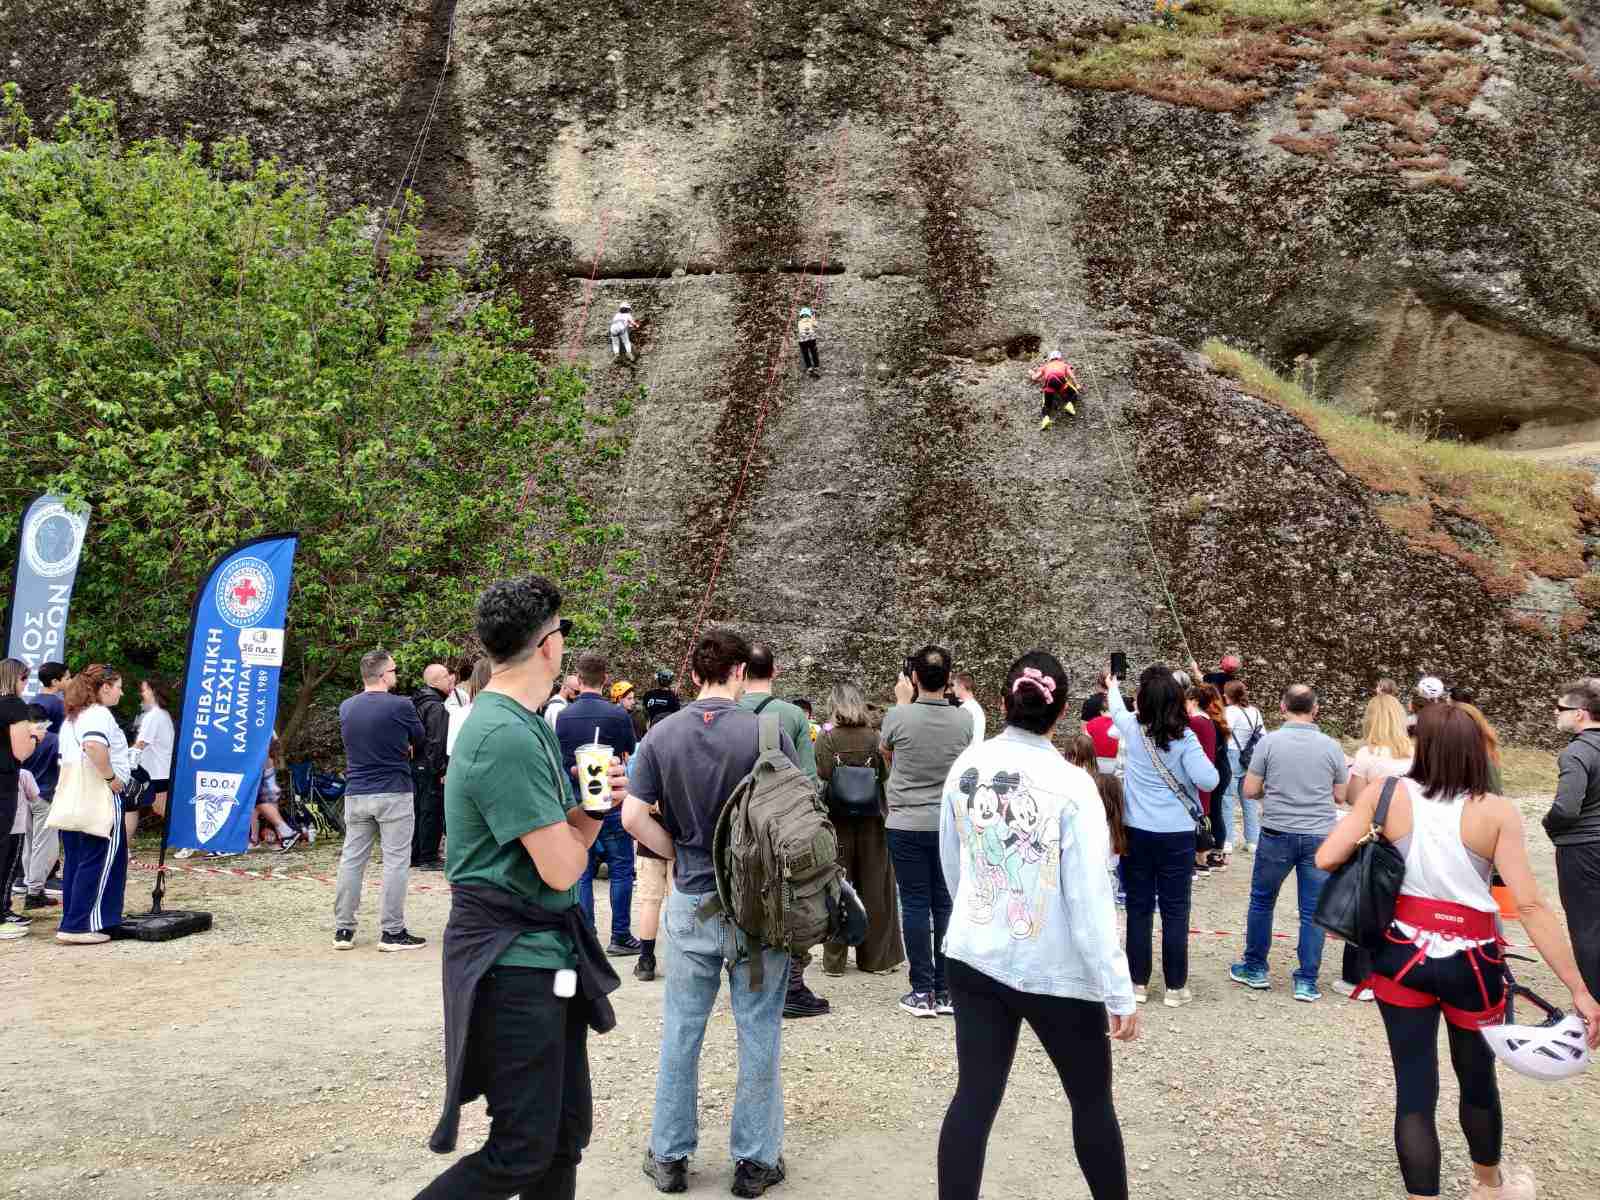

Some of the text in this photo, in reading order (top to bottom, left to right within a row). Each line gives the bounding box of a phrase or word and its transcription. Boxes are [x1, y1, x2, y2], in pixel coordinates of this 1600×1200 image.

[190, 628, 223, 760] ΟΡΕΙΒΑΤΙΚΗ
[212, 658, 237, 733] ΛΕΣΧΗ
[257, 669, 268, 692] 1989
